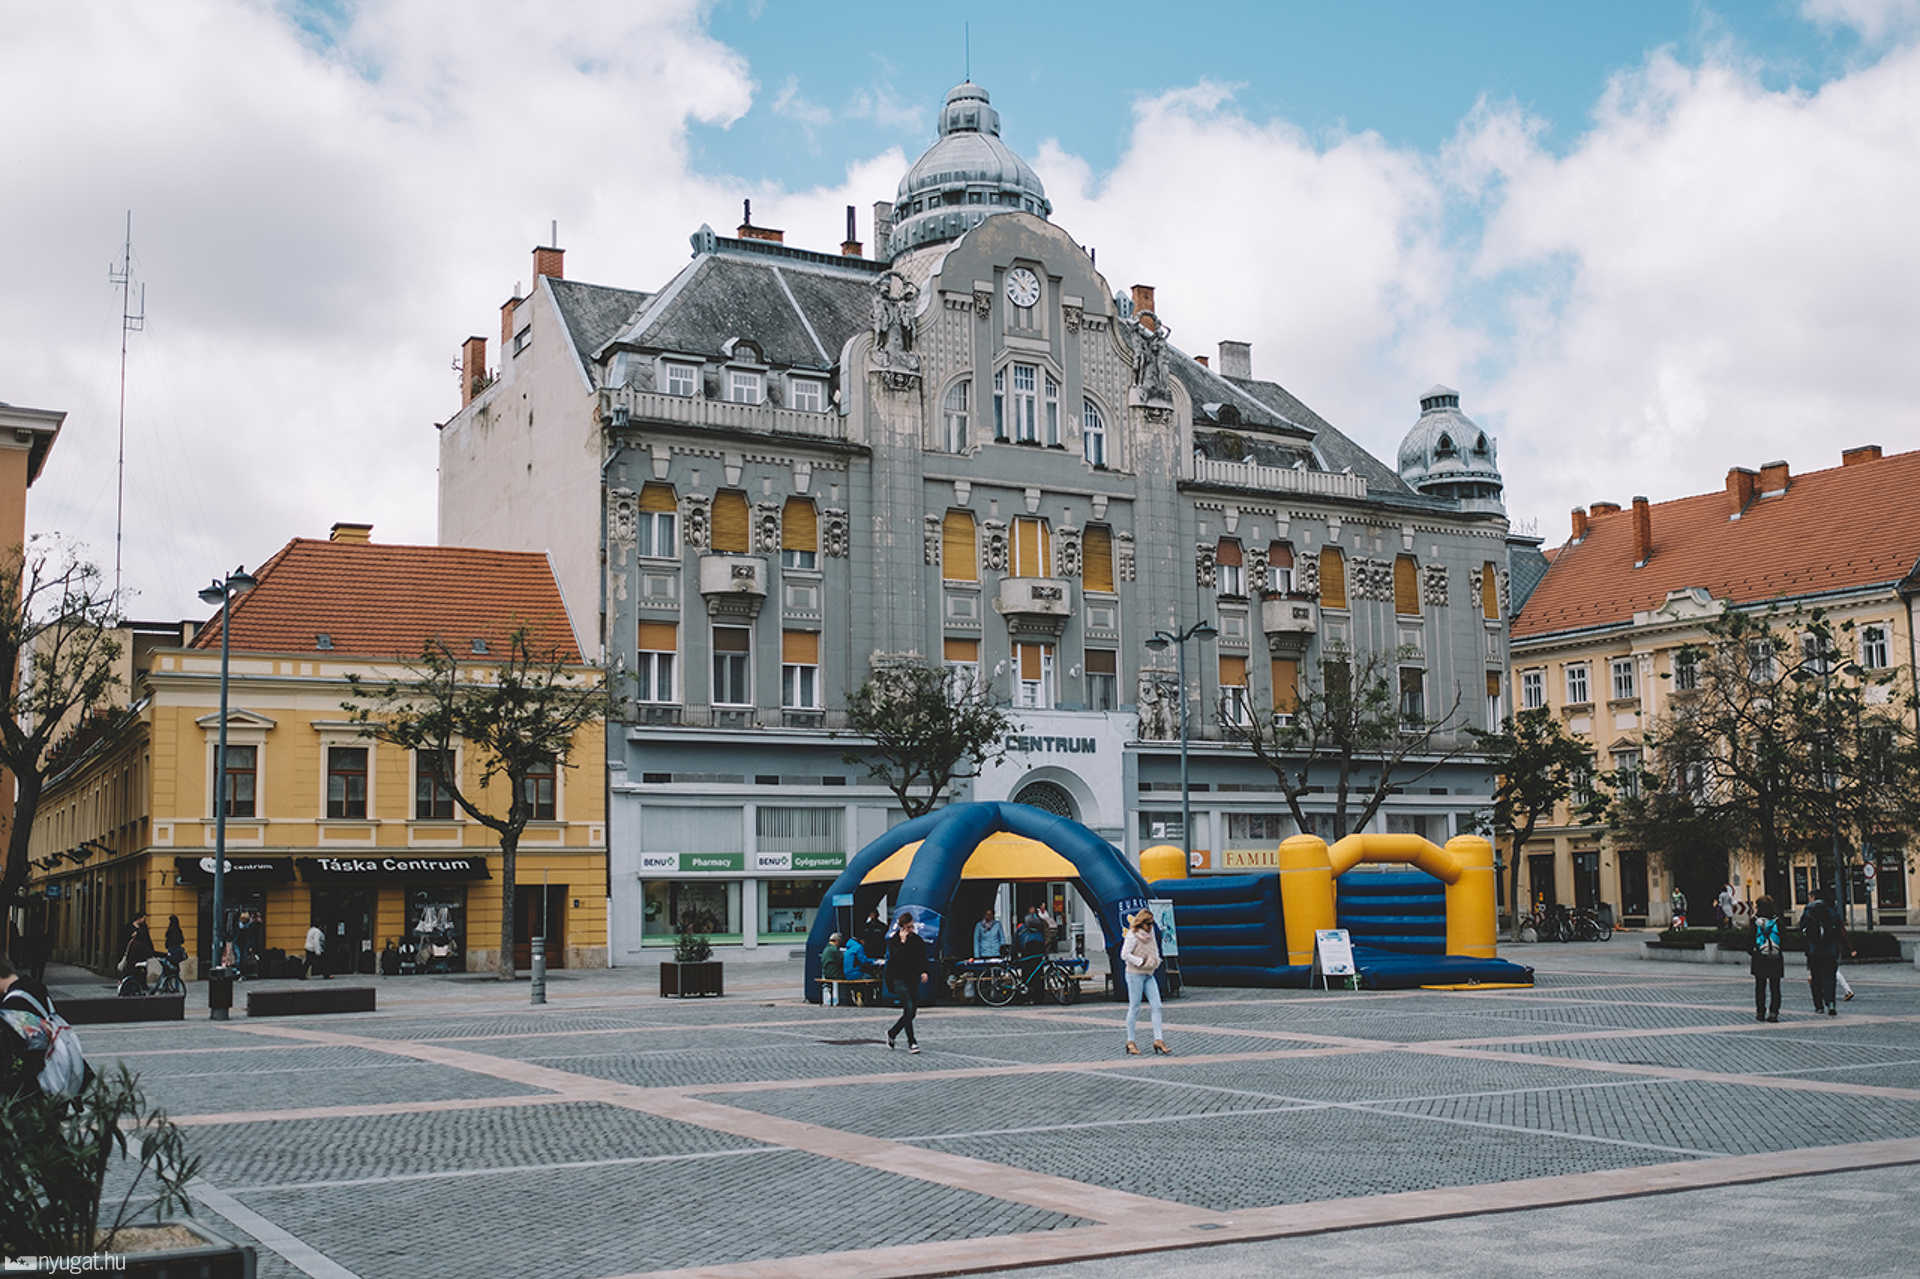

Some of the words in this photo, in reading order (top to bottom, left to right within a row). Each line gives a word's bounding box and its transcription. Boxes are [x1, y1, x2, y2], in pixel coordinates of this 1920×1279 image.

[1005, 735, 1096, 754] CENTRUM
[643, 858, 667, 867] BENU
[692, 857, 732, 868] Pharmacy
[758, 857, 780, 866] BENU
[1226, 851, 1279, 866] FAMIL
[233, 863, 274, 871] centrum
[317, 858, 378, 872] Táska
[383, 858, 471, 871] Centrum
